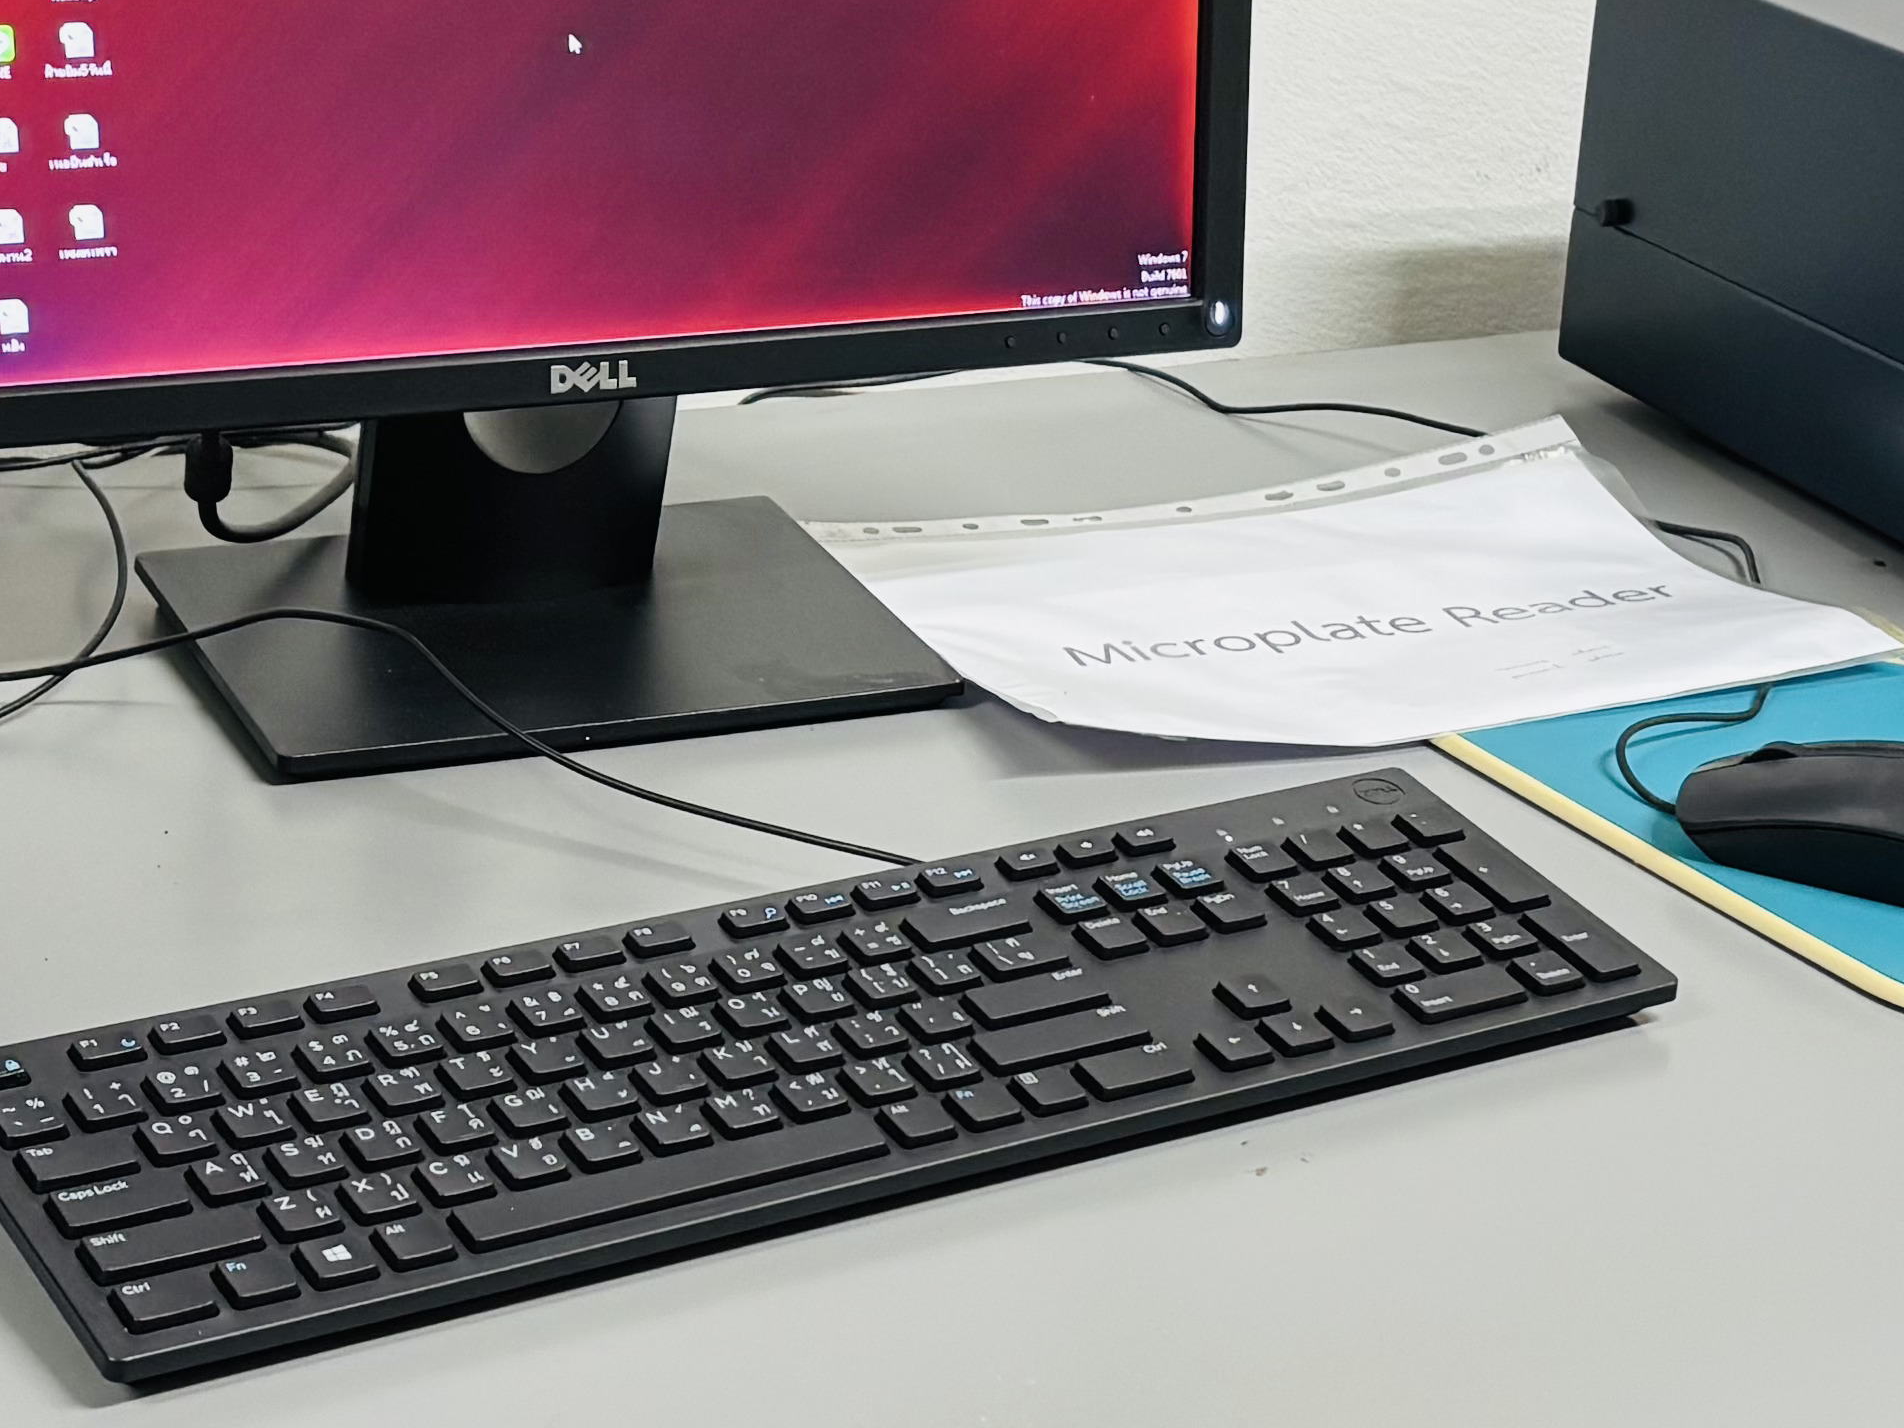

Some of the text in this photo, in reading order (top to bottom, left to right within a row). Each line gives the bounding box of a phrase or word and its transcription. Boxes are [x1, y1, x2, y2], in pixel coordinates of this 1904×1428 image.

[1137, 250, 1189, 266] Windows 7
[1021, 294, 1041, 307] This
[1042, 294, 1067, 307] copy
[1067, 291, 1078, 304] of
[1078, 288, 1122, 303] Windows
[550, 360, 637, 394] DELL
[1063, 581, 1675, 668] Microplate Reader
[792, 983, 808, 996] P
[727, 996, 746, 1010] O
[591, 1026, 610, 1041] U
[781, 1031, 800, 1044] L
[520, 1041, 539, 1055] Y
[712, 1046, 732, 1061] K
[449, 1056, 466, 1070] T
[649, 1061, 662, 1074] J
[377, 1072, 398, 1087] R
[573, 1077, 595, 1092] H
[303, 1088, 323, 1103] E
[504, 1093, 523, 1108] G
[713, 1094, 738, 1110] M
[227, 1103, 255, 1118] W
[430, 1110, 447, 1124] F
[645, 1110, 668, 1125] N
[151, 1121, 174, 1135] Q
[355, 1127, 376, 1141] D
[575, 1128, 595, 1142] B
[280, 1143, 299, 1157] S
[500, 1145, 519, 1159] V
[205, 1160, 224, 1175] A
[428, 1161, 448, 1175] C
[351, 1178, 373, 1193] X
[273, 1195, 296, 1211] Z
[385, 1223, 406, 1235] Alt
[89, 1232, 127, 1248] Shift
[225, 1260, 247, 1272] Fn
[121, 1282, 151, 1296] Ctrl
